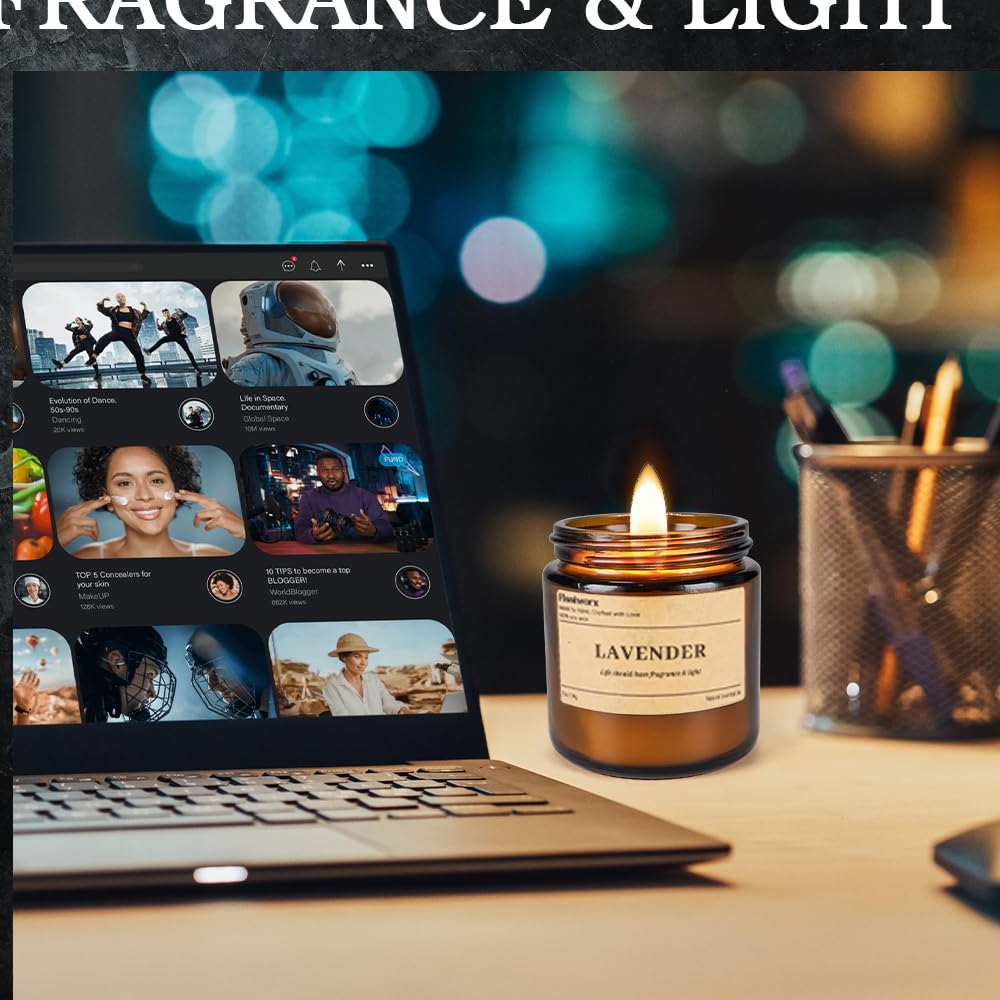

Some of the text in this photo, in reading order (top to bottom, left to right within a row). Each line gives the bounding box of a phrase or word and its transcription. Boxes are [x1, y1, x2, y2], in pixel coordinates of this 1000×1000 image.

[91, 396, 117, 404] Dance.
[239, 394, 253, 402] Life
[262, 394, 287, 403] Space.
[241, 404, 289, 412] Documentary
[51, 416, 82, 424] Dancing
[267, 415, 290, 423] Space
[75, 571, 91, 579] TOP
[99, 570, 140, 578] Concealers
[141, 570, 152, 578] for
[338, 567, 351, 575] top
[77, 580, 110, 590] your skin
[269, 588, 319, 596] WorldBlogger
[594, 643, 706, 661] LAVENDER
